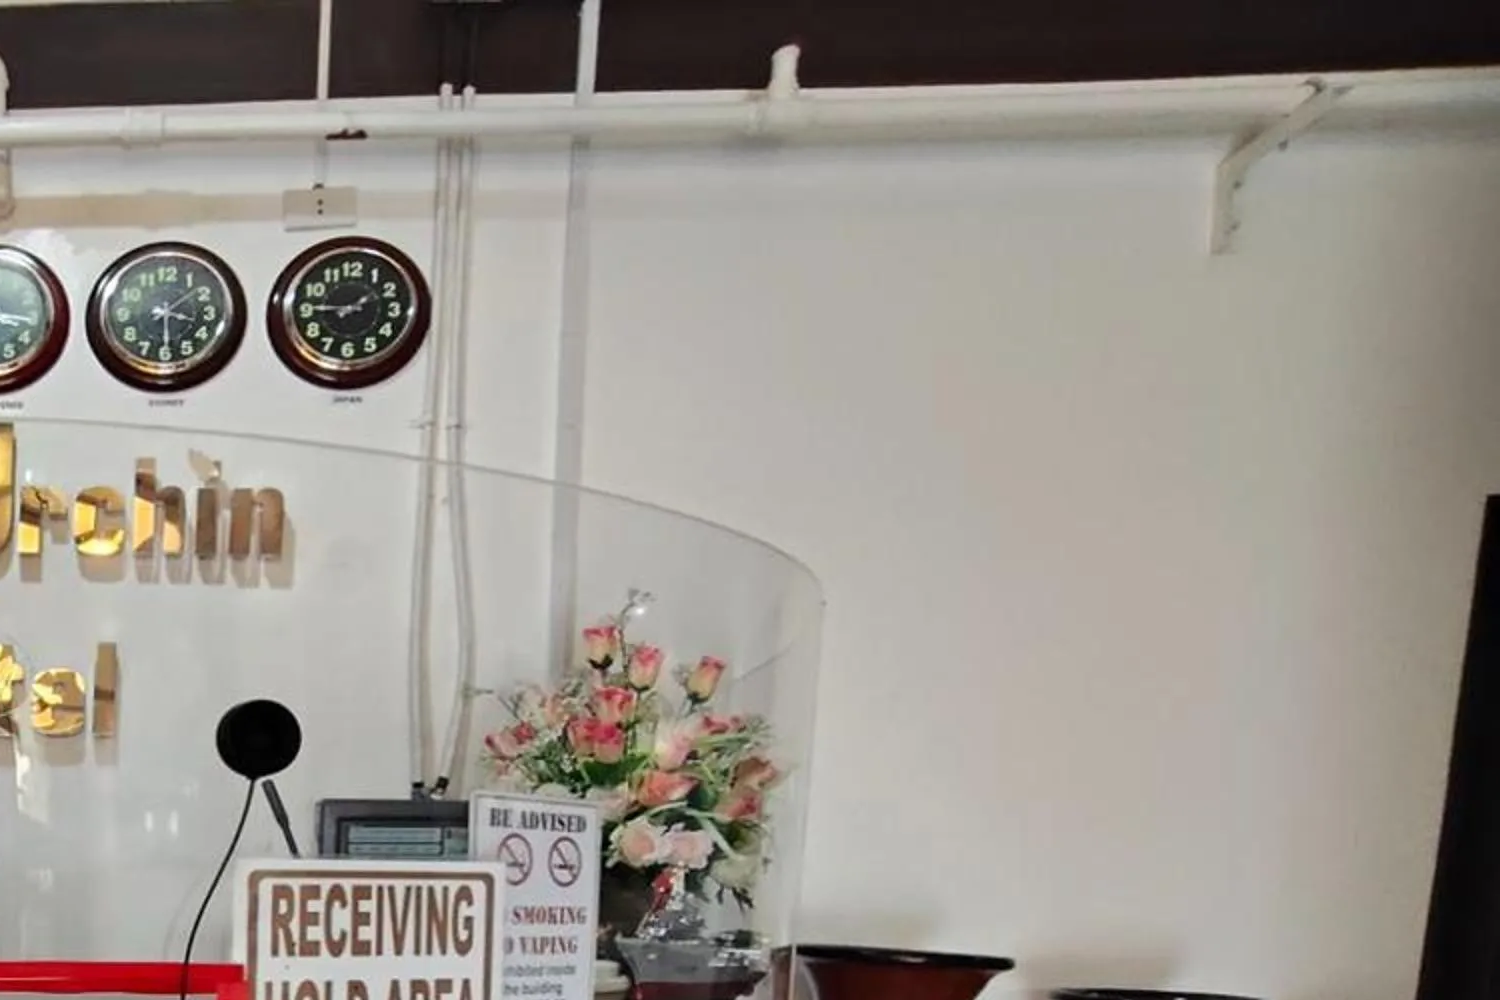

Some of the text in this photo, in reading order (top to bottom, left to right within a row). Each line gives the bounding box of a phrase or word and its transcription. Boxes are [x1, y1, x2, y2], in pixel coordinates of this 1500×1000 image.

[158, 266, 177, 281] 12
[324, 268, 339, 282] 11
[342, 262, 362, 277] 12
[371, 269, 378, 283] 1
[140, 273, 155, 286] 11
[186, 273, 193, 287] 1
[122, 288, 141, 301] 10
[198, 287, 211, 301] 2
[306, 283, 325, 296] 10
[383, 283, 396, 297] 2
[116, 307, 130, 321] 9
[204, 306, 215, 320] 3
[300, 304, 313, 317] 9
[388, 303, 400, 317] 3
[124, 327, 136, 341] 8
[195, 326, 208, 340] 4
[307, 323, 320, 337] 8
[379, 323, 392, 337] 4
[19, 331, 30, 344] 4
[364, 337, 376, 352] 5
[4, 344, 15, 358] 5
[139, 342, 150, 355] 7
[181, 342, 193, 355] 5
[321, 338, 334, 352] 7
[341, 343, 354, 357] 6
[159, 346, 171, 360] 6
[490, 808, 587, 832] BE ADVISED
[270, 884, 474, 957] RECEIVING
[512, 906, 587, 924] SMOKING
[519, 936, 578, 955] VAPING
